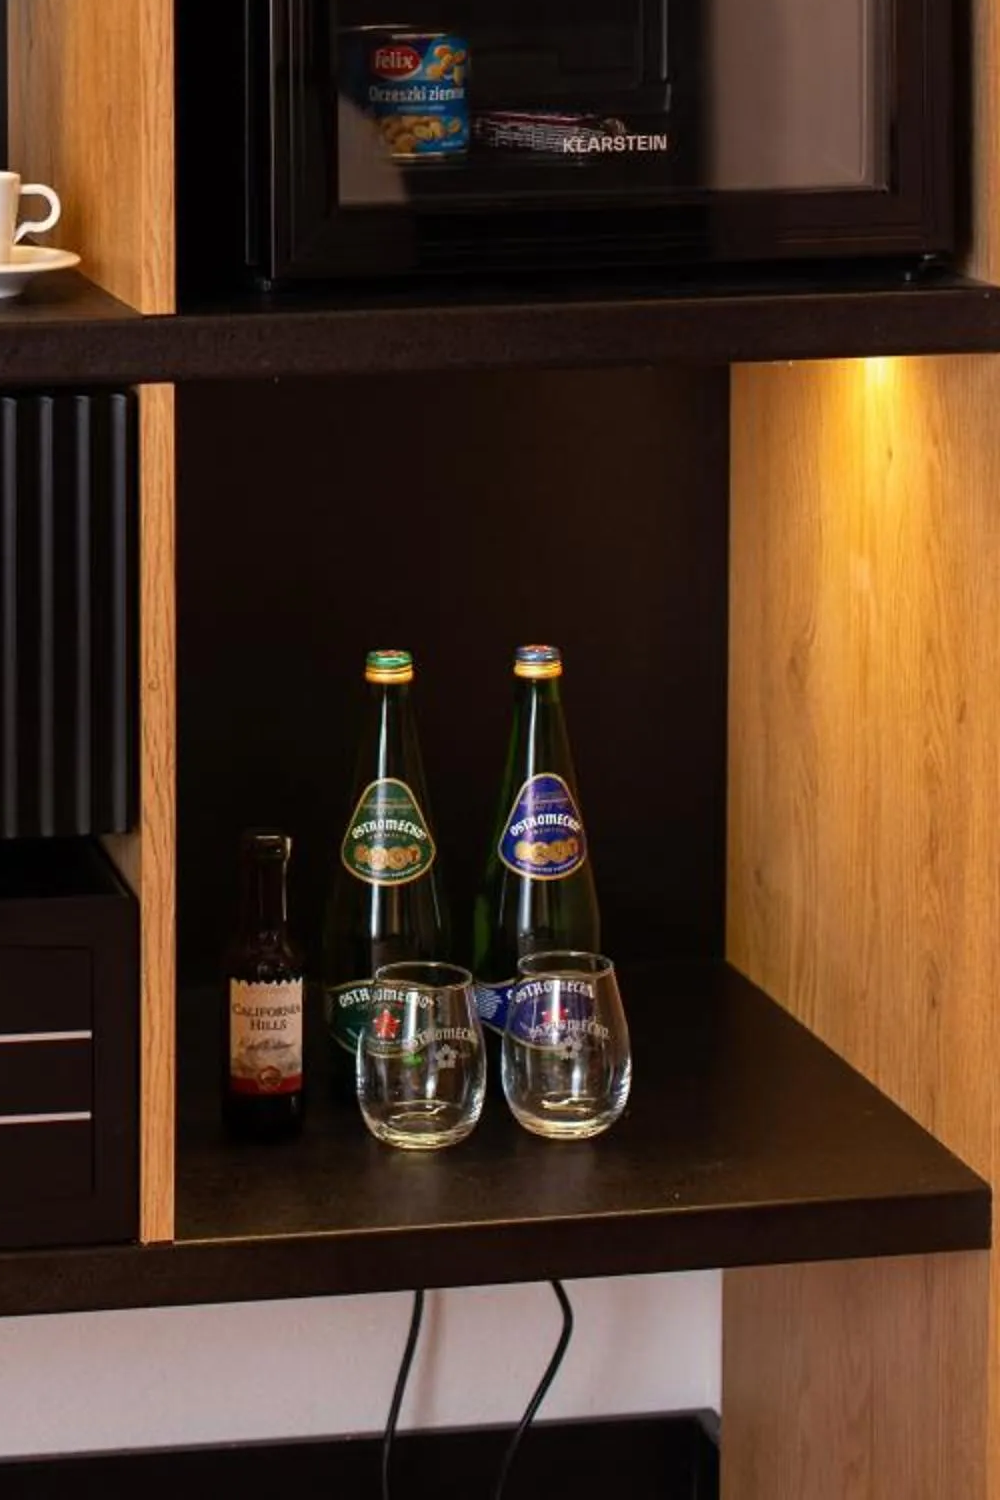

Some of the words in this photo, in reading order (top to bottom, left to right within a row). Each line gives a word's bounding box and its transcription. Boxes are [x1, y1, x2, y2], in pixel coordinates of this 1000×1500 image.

[375, 49, 415, 70] Felix
[563, 134, 667, 153] KLARSTEIN
[250, 1017, 288, 1031] HILLS
